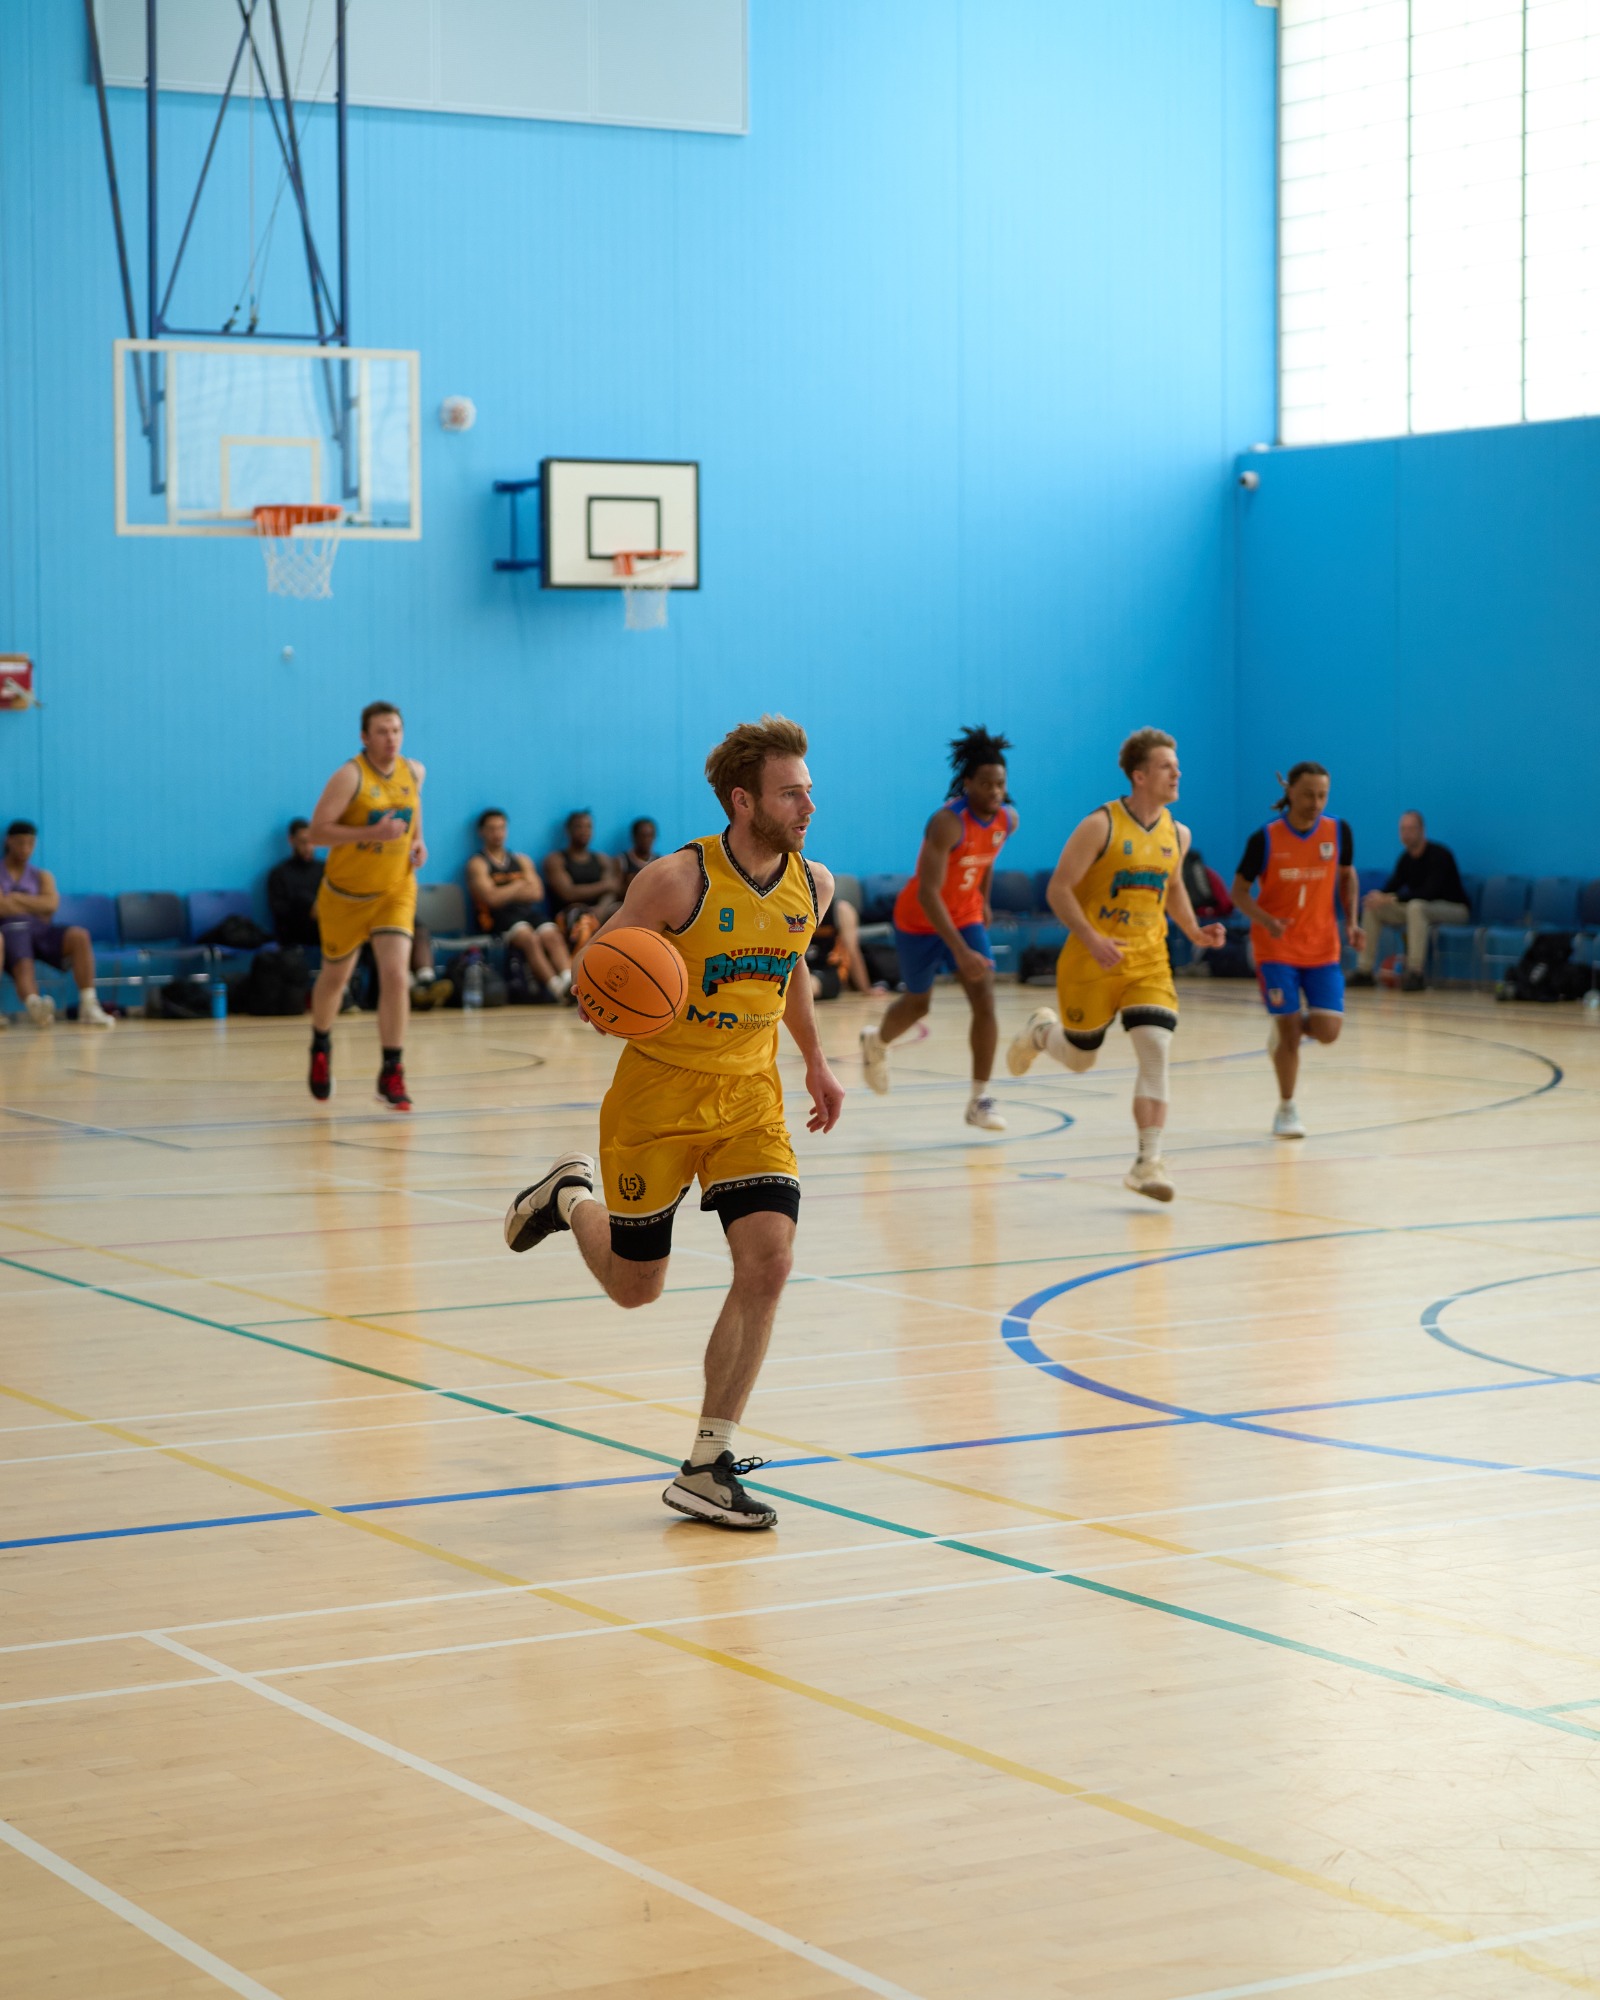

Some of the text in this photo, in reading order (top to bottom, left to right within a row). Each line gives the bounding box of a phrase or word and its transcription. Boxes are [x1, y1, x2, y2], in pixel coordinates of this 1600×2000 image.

[959, 867, 977, 891] 5
[719, 908, 734, 932] 9
[624, 1177, 637, 1191] 15
